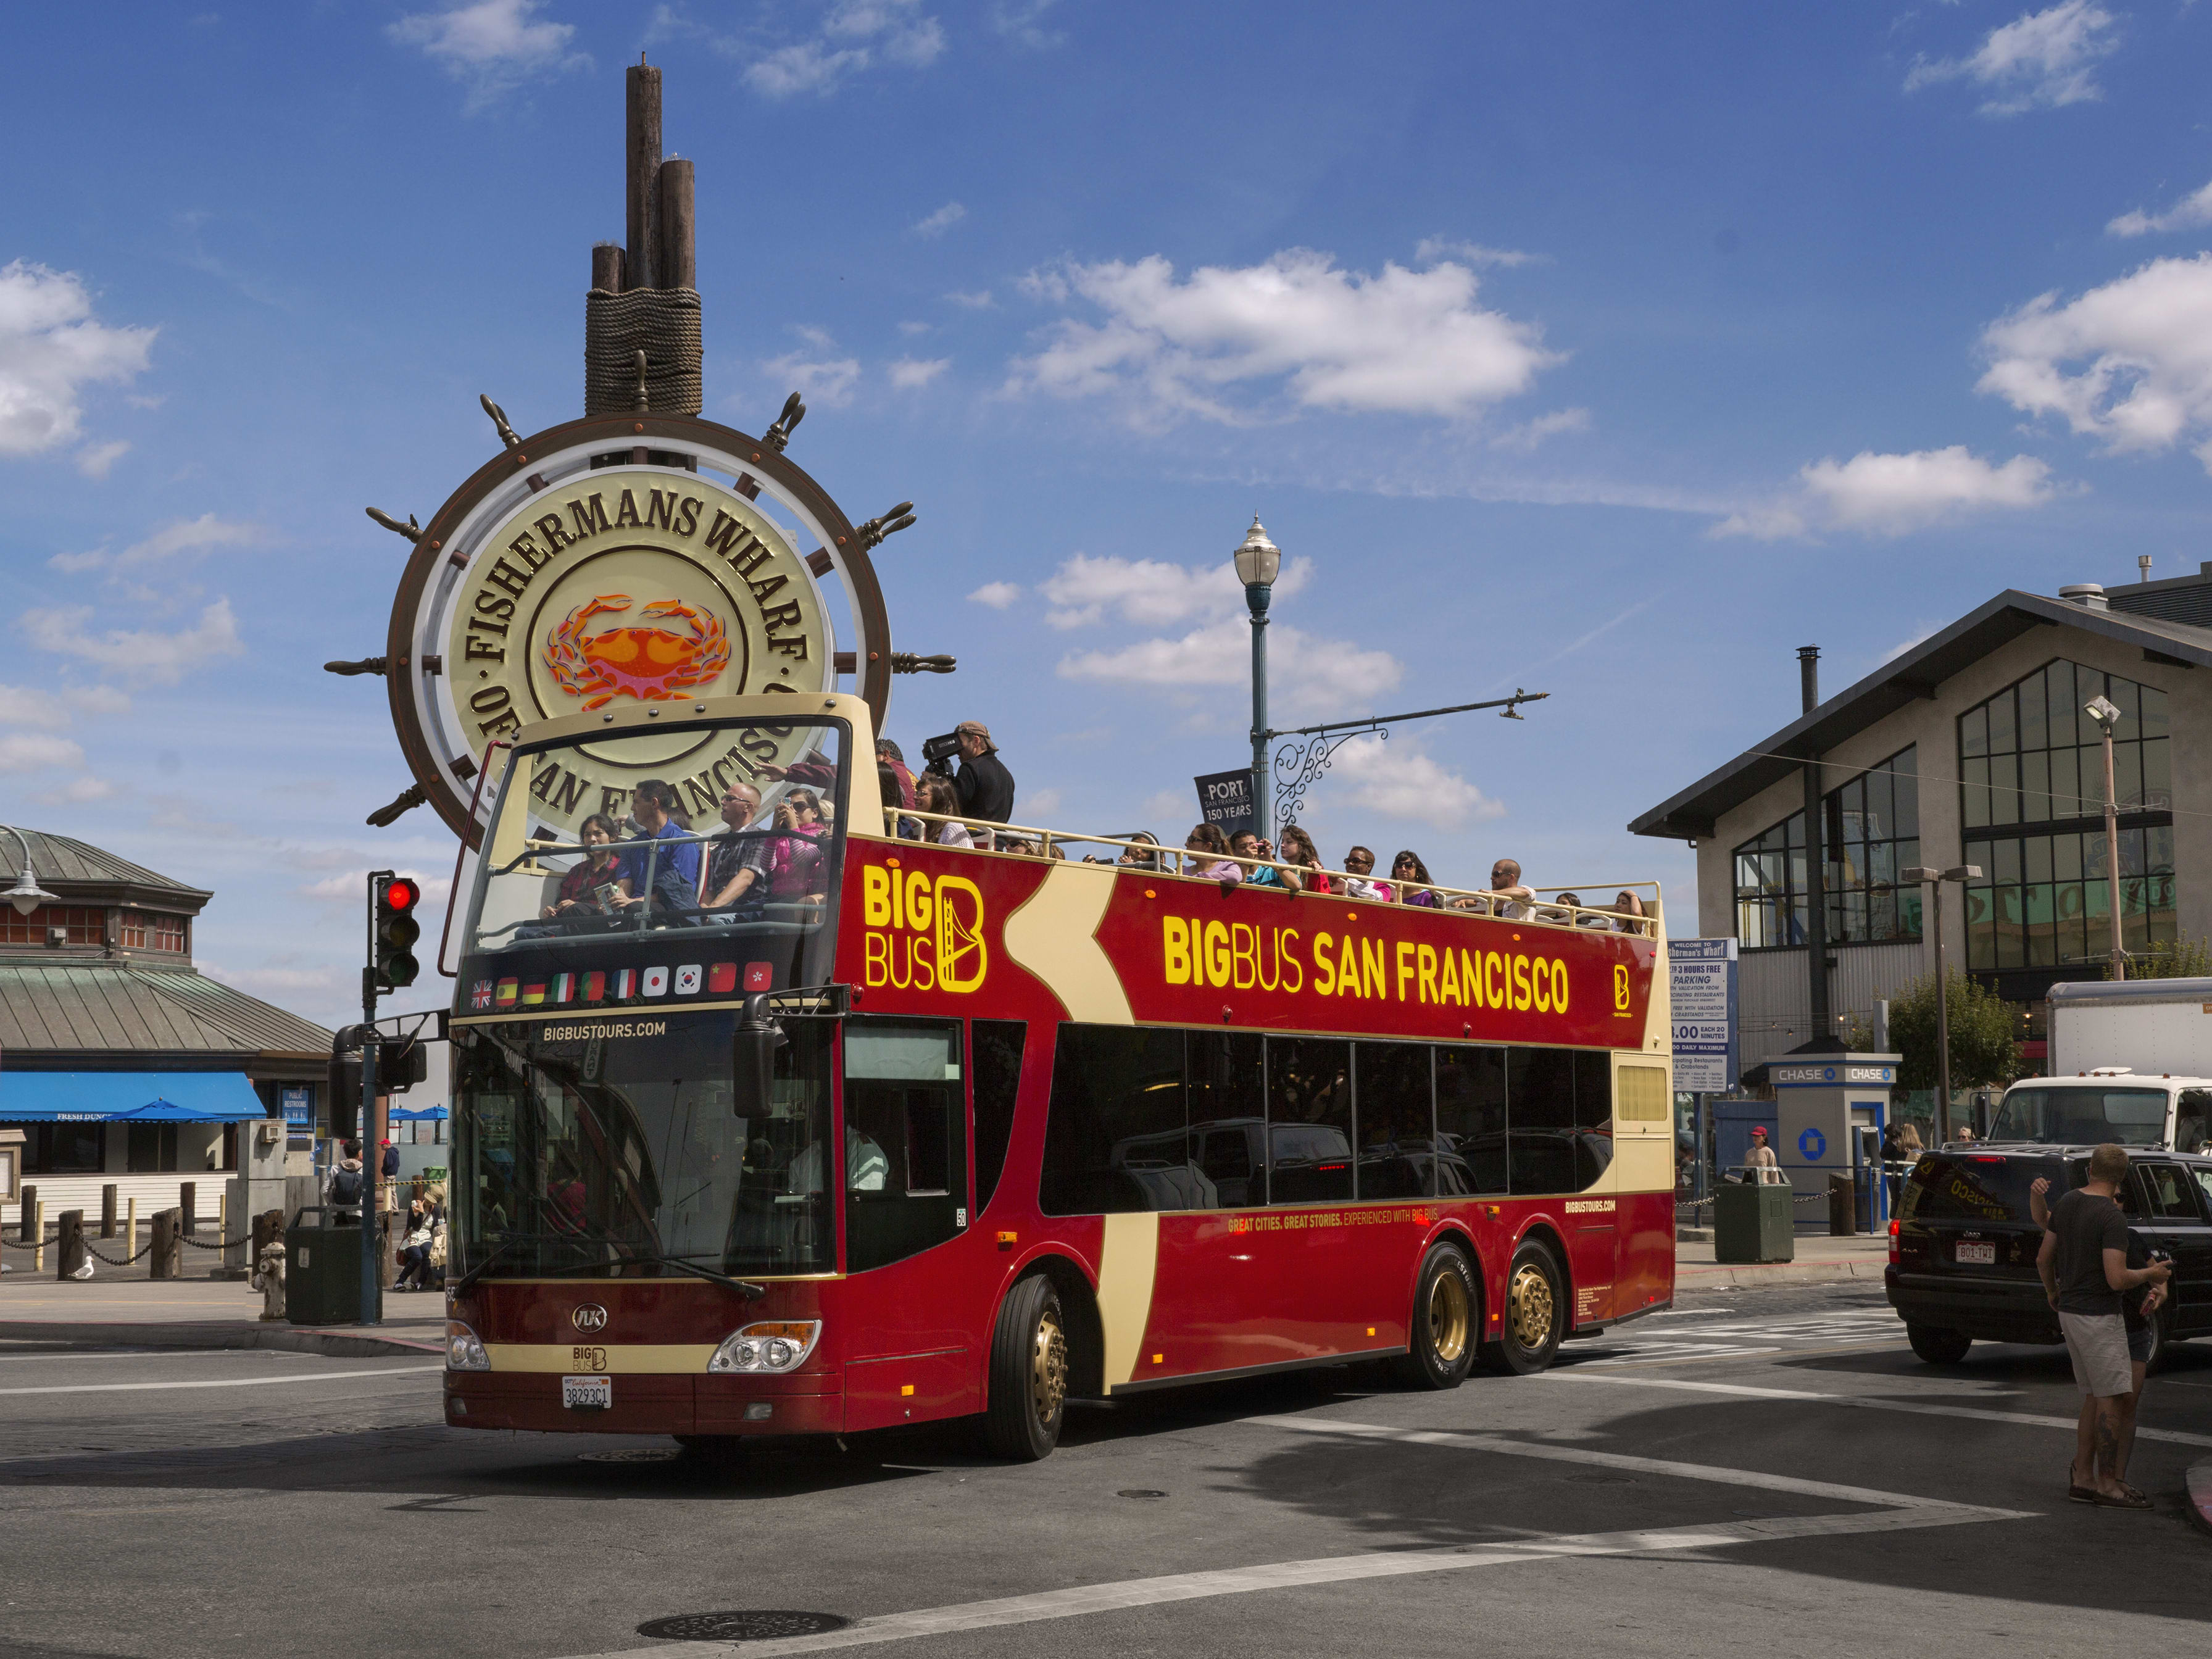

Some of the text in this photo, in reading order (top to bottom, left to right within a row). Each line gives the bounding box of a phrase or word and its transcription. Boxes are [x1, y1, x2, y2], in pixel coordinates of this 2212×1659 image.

[465, 489, 807, 664] FISHERMANS WHARF
[1208, 780, 1244, 800] PORT
[1205, 796, 1250, 808] SAN FRANCISCO
[1207, 804, 1252, 821] 150 YEARS
[863, 865, 933, 931] BIG
[1668, 942, 1724, 957] sherman's Wharf
[865, 931, 934, 991] BUS
[1313, 931, 1386, 1000] SAN
[1397, 941, 1569, 1015] FRANCISCO
[1678, 965, 1682, 973] 3
[1684, 965, 1705, 973] HOURS
[1707, 965, 1721, 973] FREE
[1673, 976, 1711, 984] PARKING
[544, 1021, 665, 1041] BIGBUSTOURS.COM
[1779, 1069, 1822, 1080] CHASE
[1852, 1068, 1882, 1079] CHASE
[1565, 1200, 1616, 1213] BIGBUSTOURS.COM
[958, 1213, 965, 1224] 50
[1228, 1218, 1254, 1233] GREAT
[1255, 1216, 1283, 1231] CITIES.
[1284, 1214, 1308, 1230] GREAT
[1310, 1213, 1342, 1228] STORIES.
[1344, 1210, 1391, 1226] EXPERIENCED
[1393, 1209, 1411, 1223] WITH
[1412, 1208, 1423, 1221] BIG
[1963, 1231, 1981, 1239] Jeep
[573, 1347, 591, 1359] BIG
[573, 1360, 591, 1371] BUS
[572, 1378, 599, 1387] California
[566, 1388, 607, 1403] 38293C1
